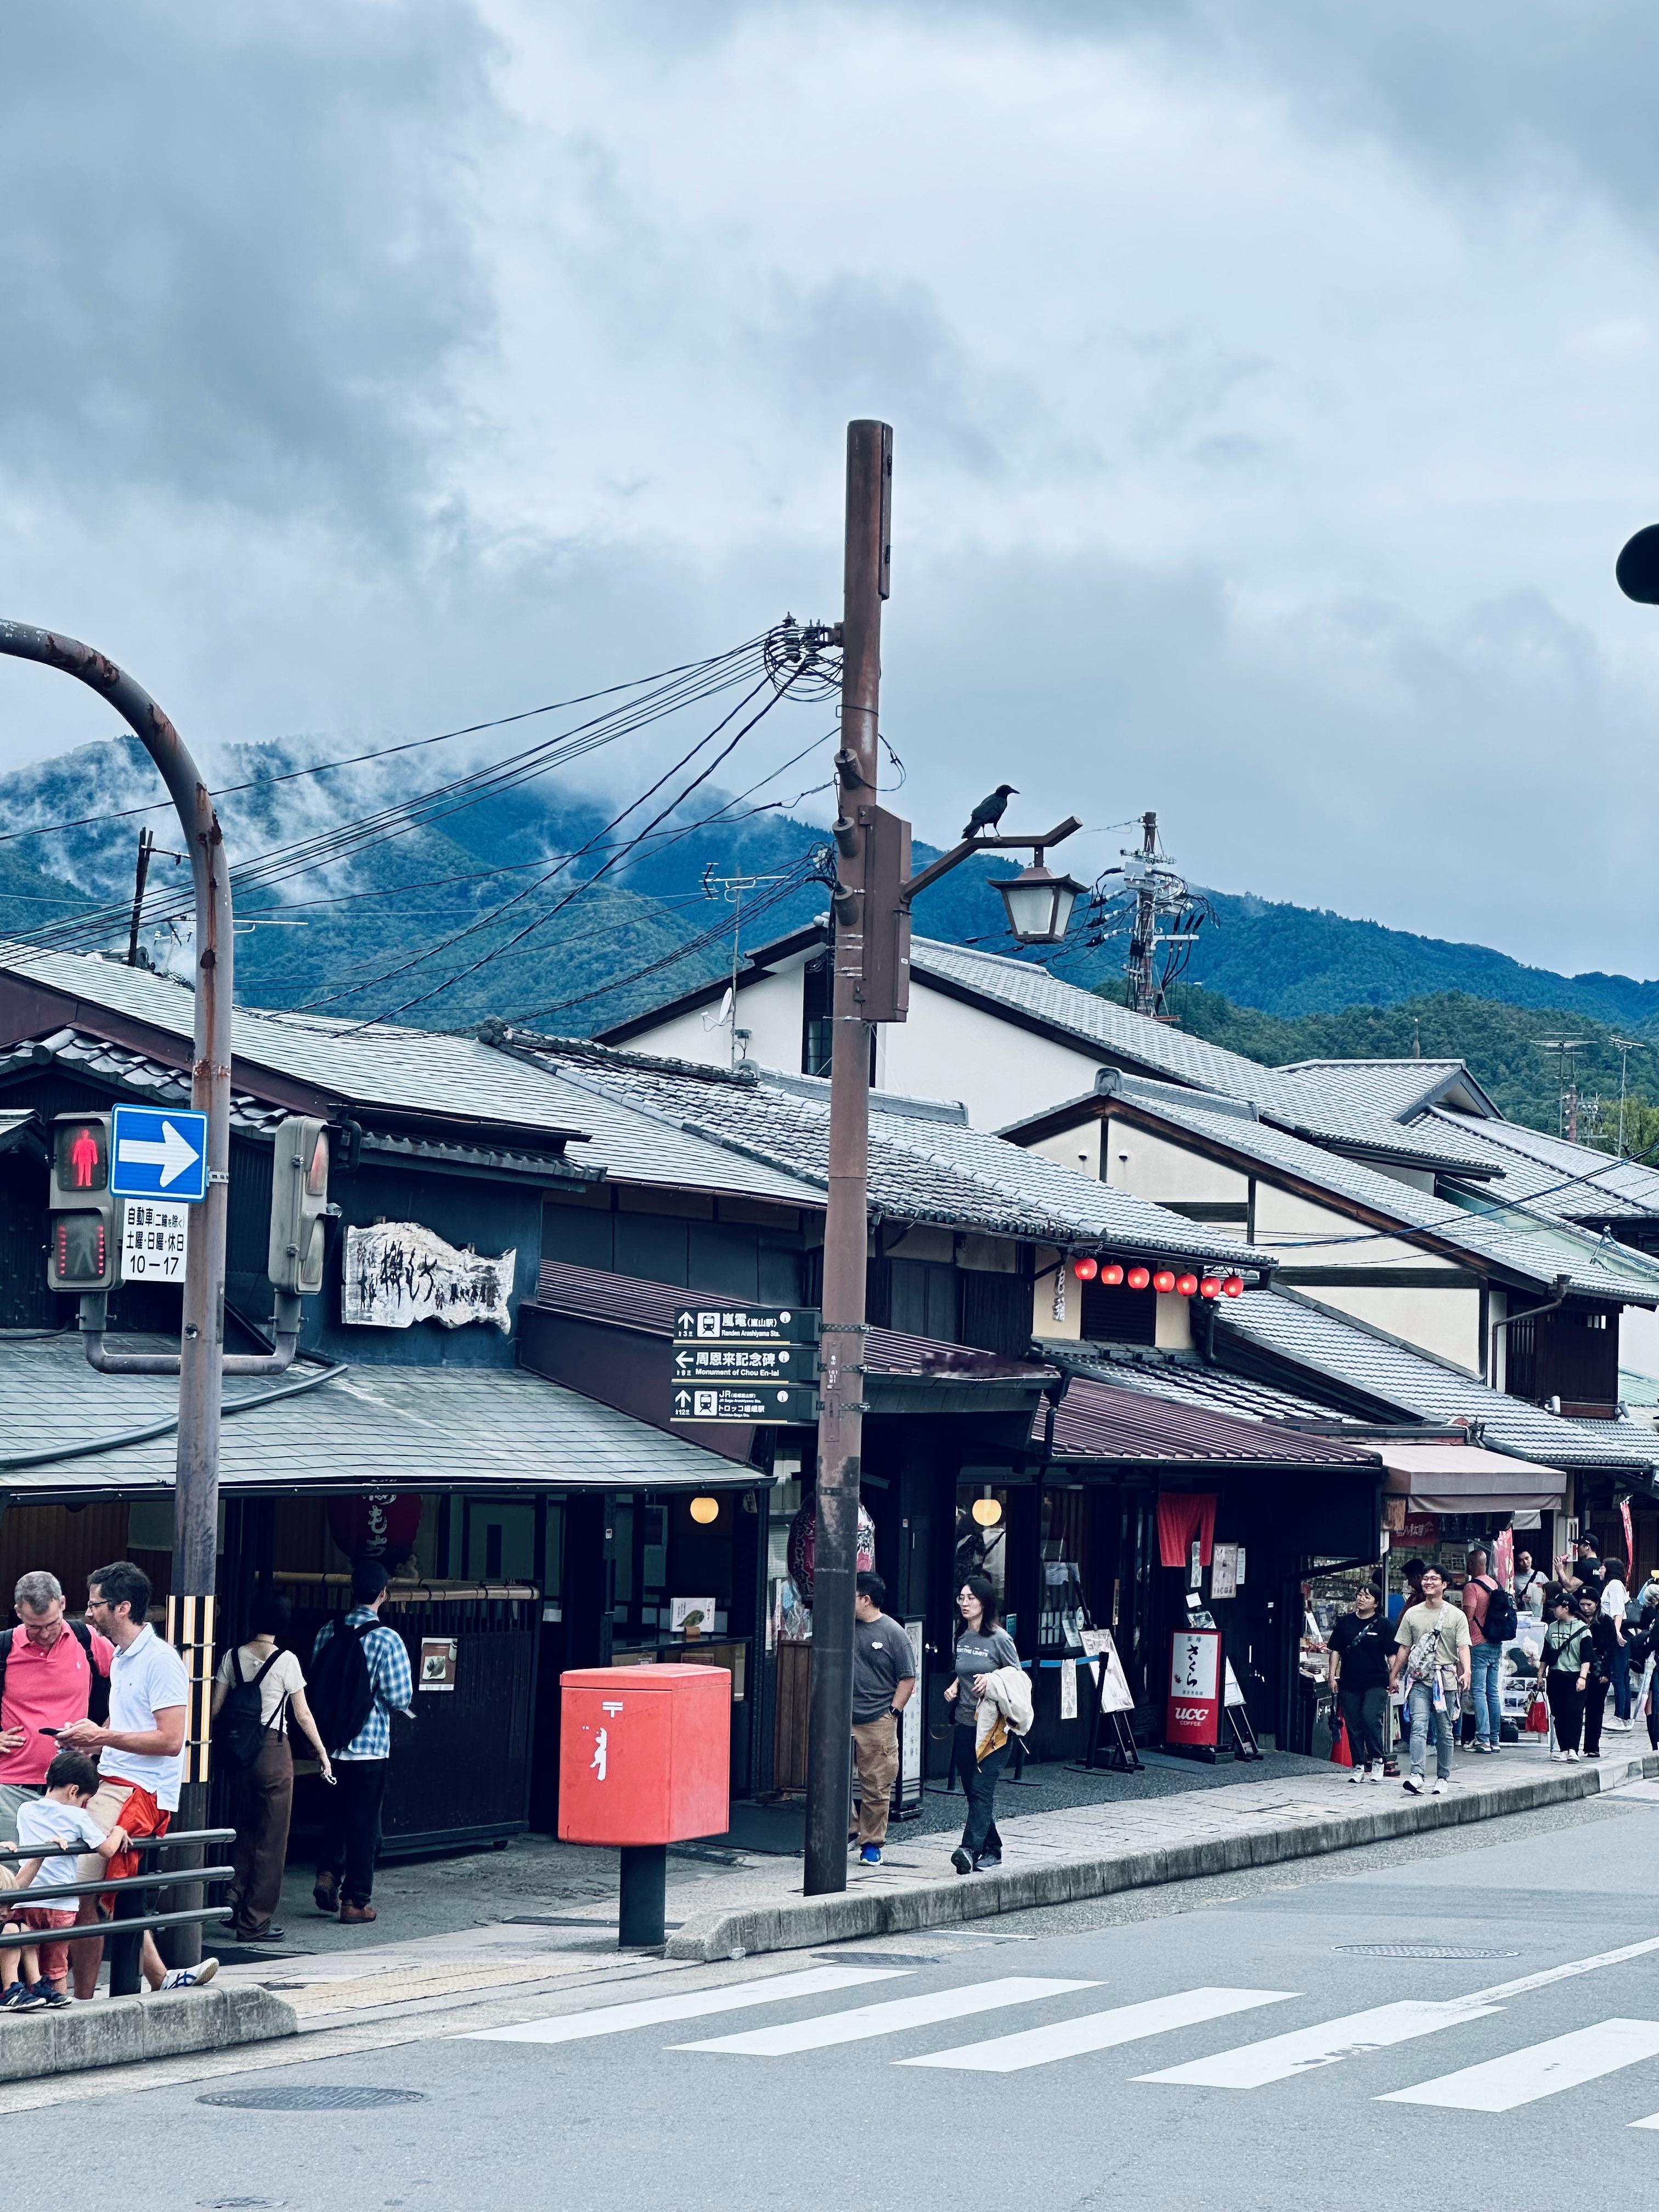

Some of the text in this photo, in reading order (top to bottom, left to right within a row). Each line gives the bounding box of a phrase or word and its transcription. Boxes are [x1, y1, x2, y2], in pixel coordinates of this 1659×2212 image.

[696, 1352, 776, 1367] 周恩来記念碑
[695, 1368, 730, 1376] Monument
[1187, 1644, 1199, 1687] さくら
[1175, 1707, 1209, 1722] UCC
